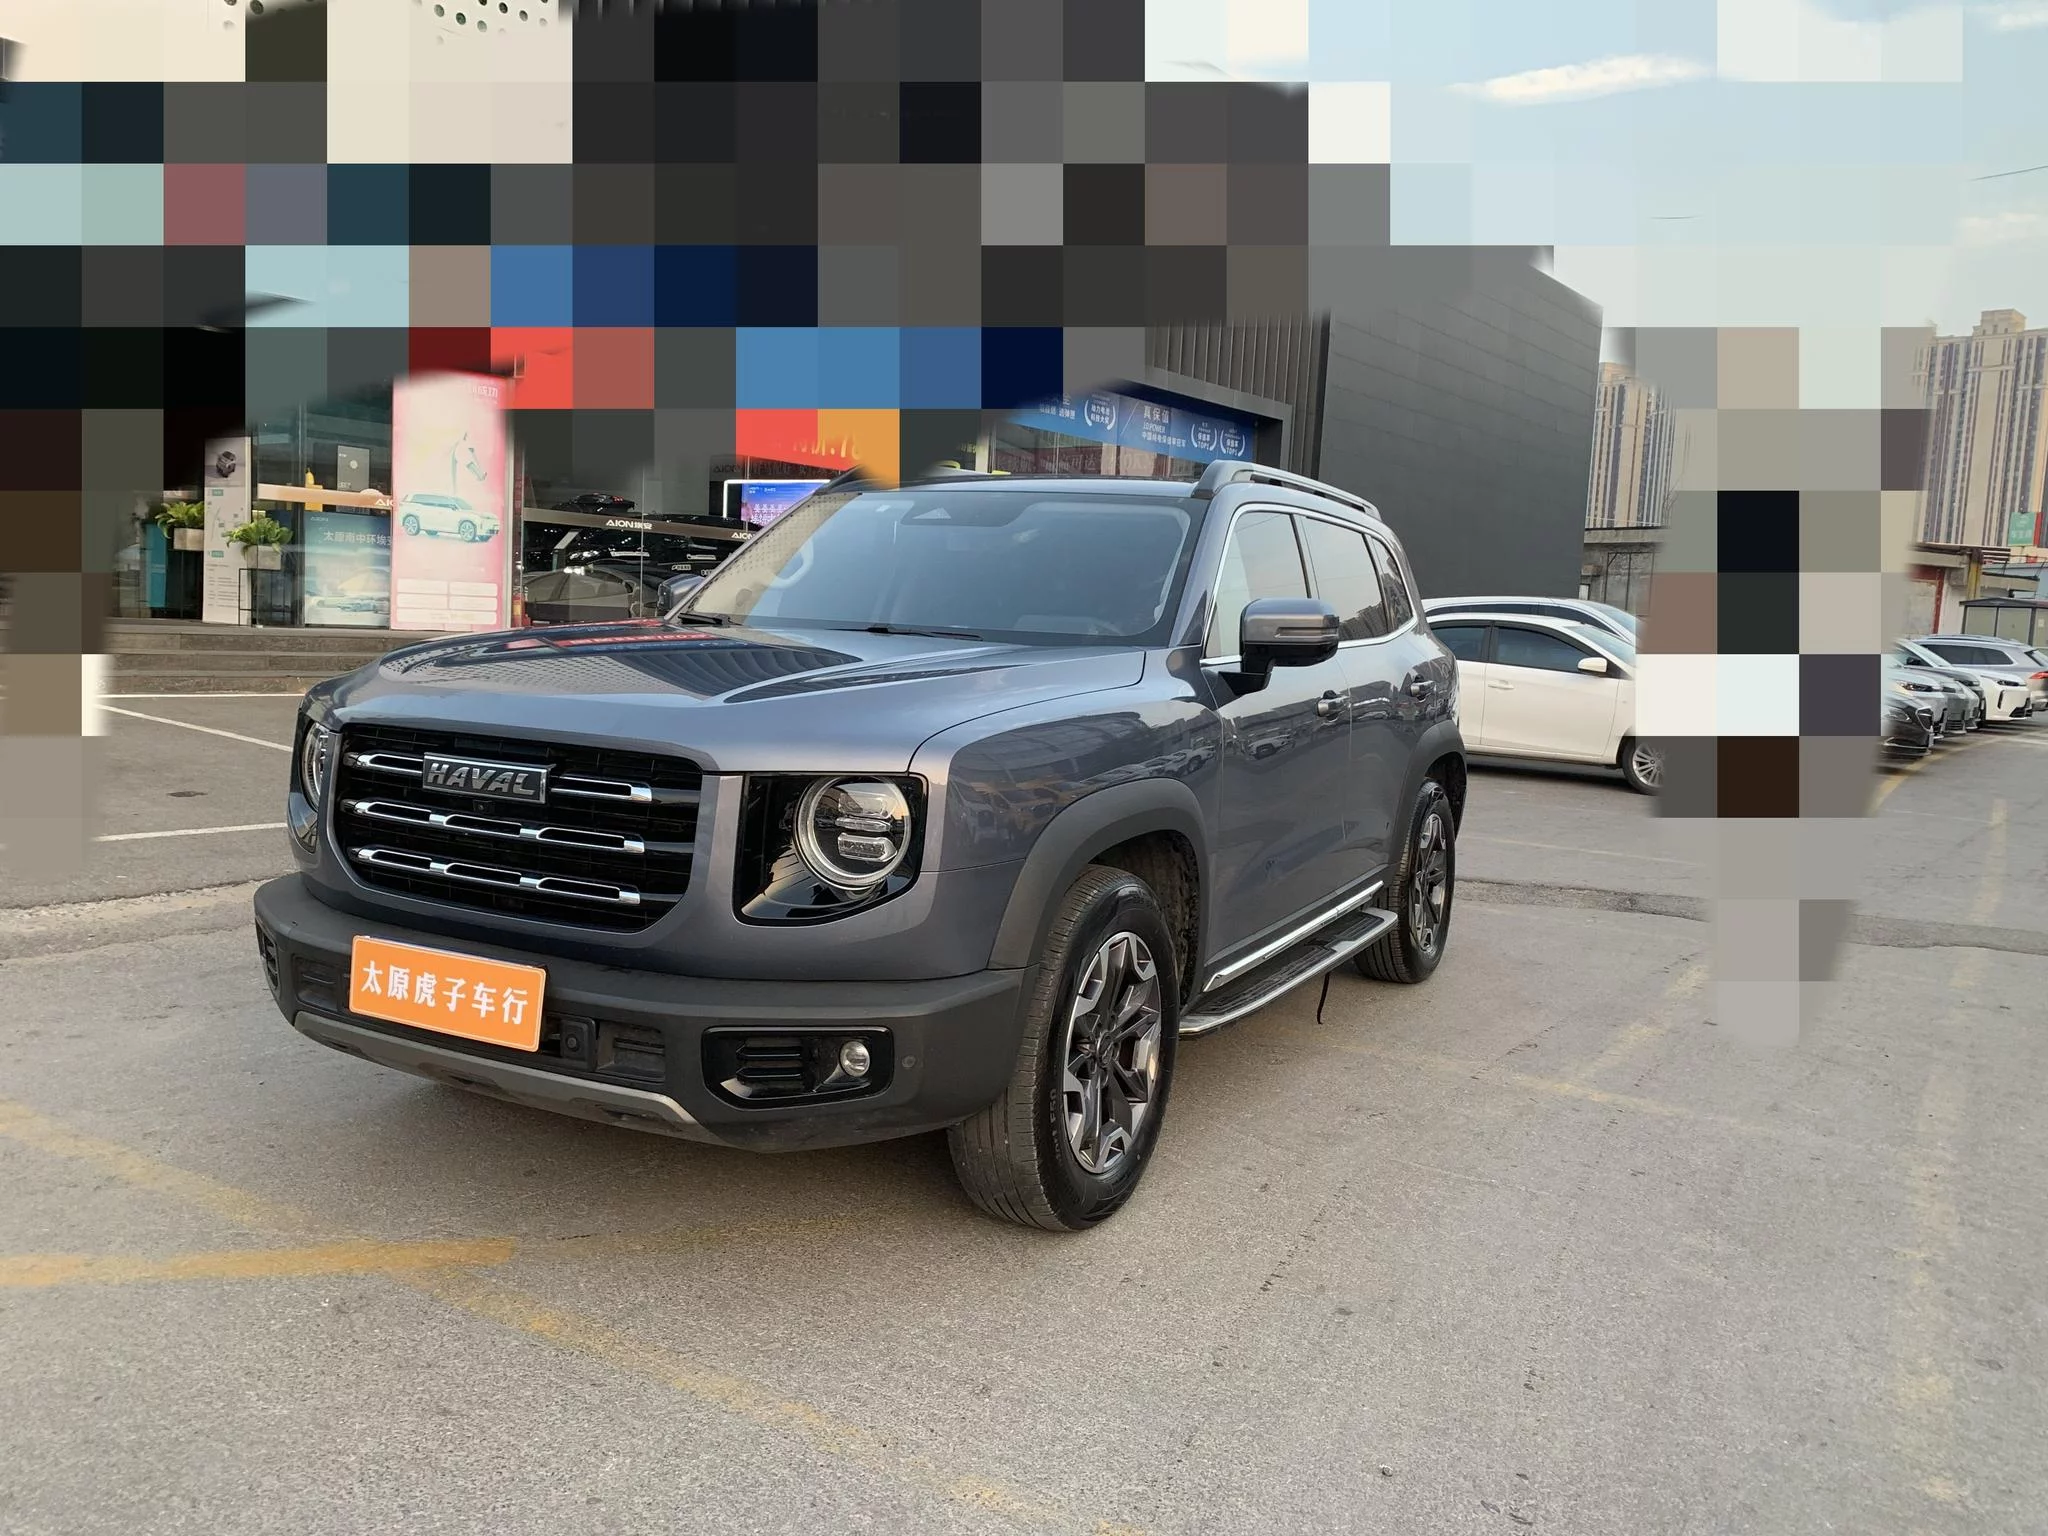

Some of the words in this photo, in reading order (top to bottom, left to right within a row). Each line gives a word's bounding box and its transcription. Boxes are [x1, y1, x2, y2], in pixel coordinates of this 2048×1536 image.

[606, 519, 634, 529] AION
[427, 762, 535, 796] HAVAL
[360, 960, 529, 1026] 太原虎子车行
